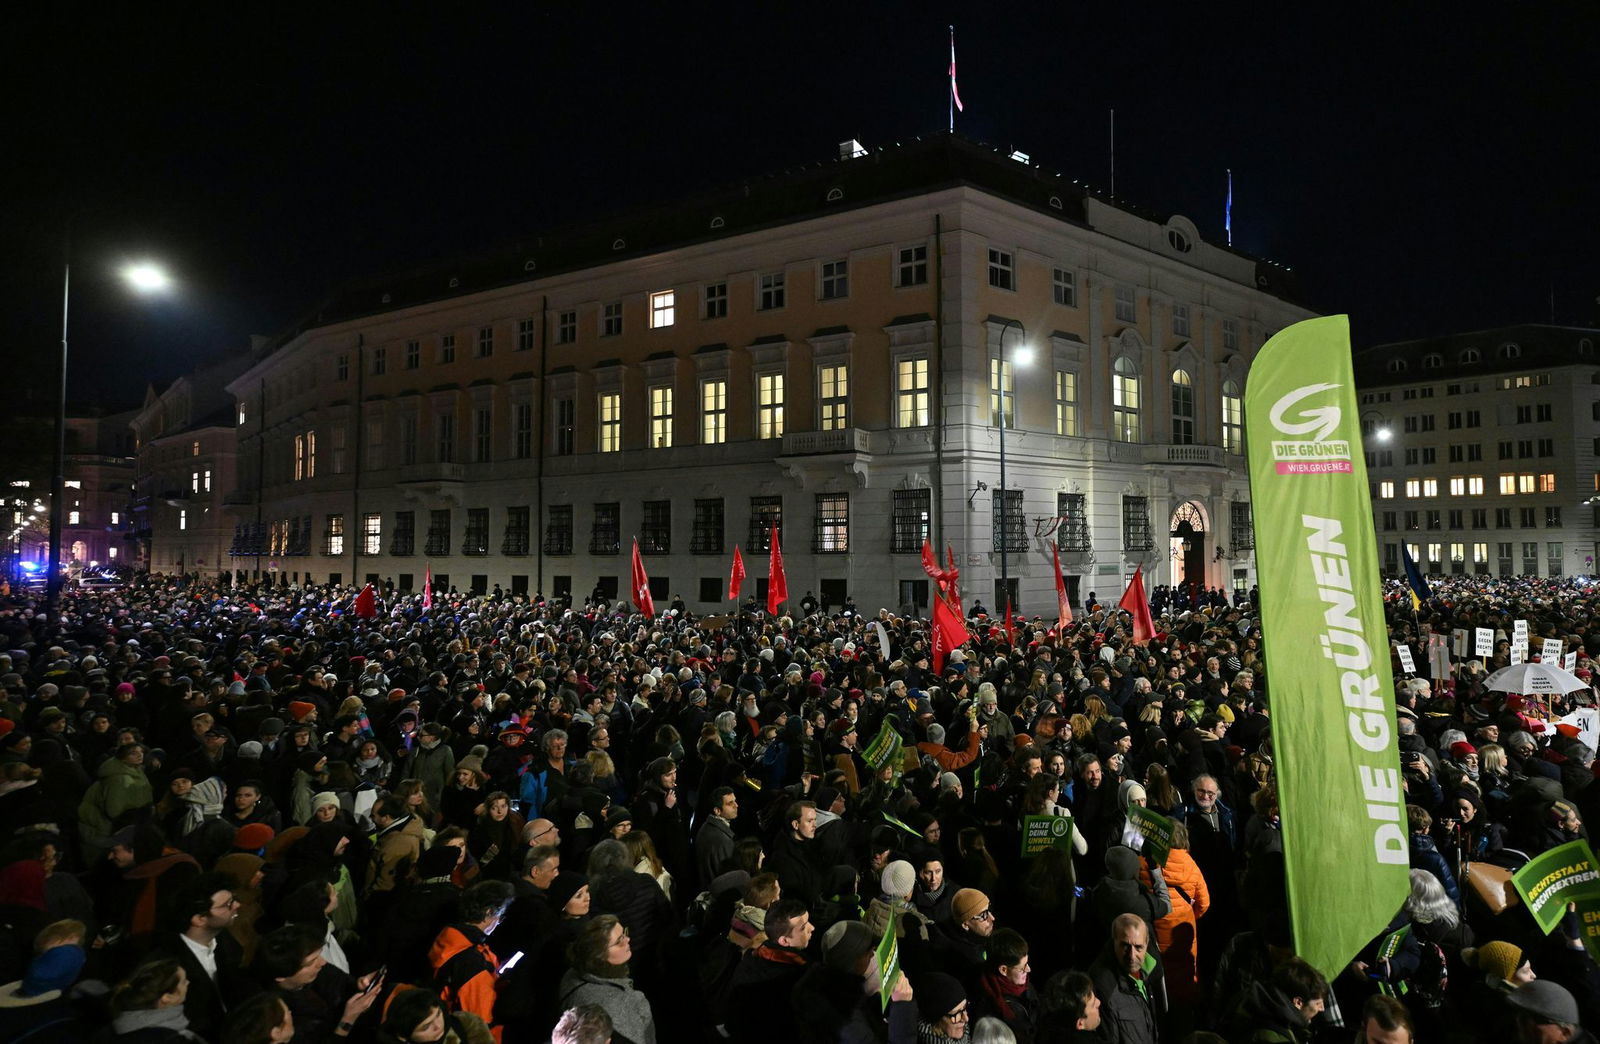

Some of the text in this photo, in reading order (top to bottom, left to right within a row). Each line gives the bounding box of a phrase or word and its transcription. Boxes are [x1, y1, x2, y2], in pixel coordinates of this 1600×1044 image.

[1275, 442, 1349, 457] DIE GRÜNEN
[1287, 463, 1351, 473] WIEN.GRUENE.AT
[1301, 513, 1410, 865] DIE GRÜNEN
[1029, 821, 1051, 830] HALTE
[1028, 829, 1050, 837] DEINE
[1528, 861, 1589, 902] RECHTSSTAAT
